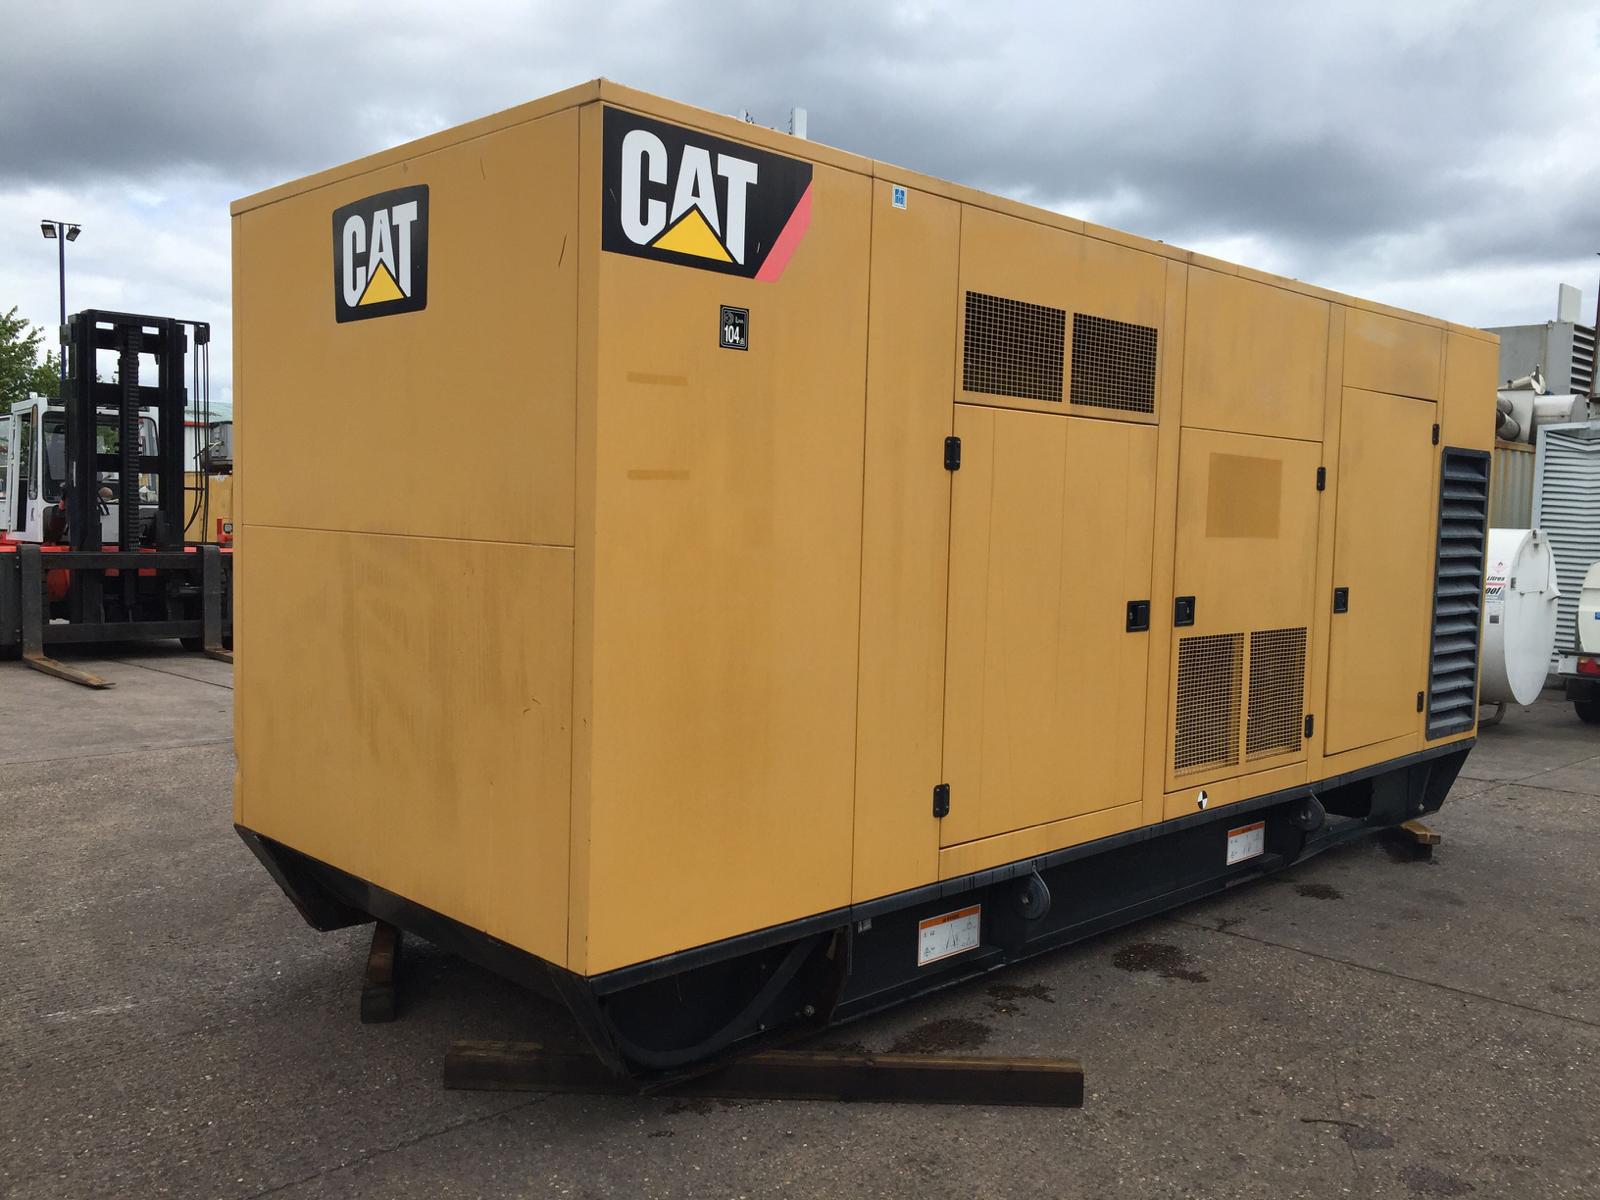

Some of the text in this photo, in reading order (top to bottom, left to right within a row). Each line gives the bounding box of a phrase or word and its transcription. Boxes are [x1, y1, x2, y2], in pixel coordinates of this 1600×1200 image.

[621, 129, 759, 266] CAT
[342, 200, 418, 308] CAT
[724, 325, 740, 344] 104
